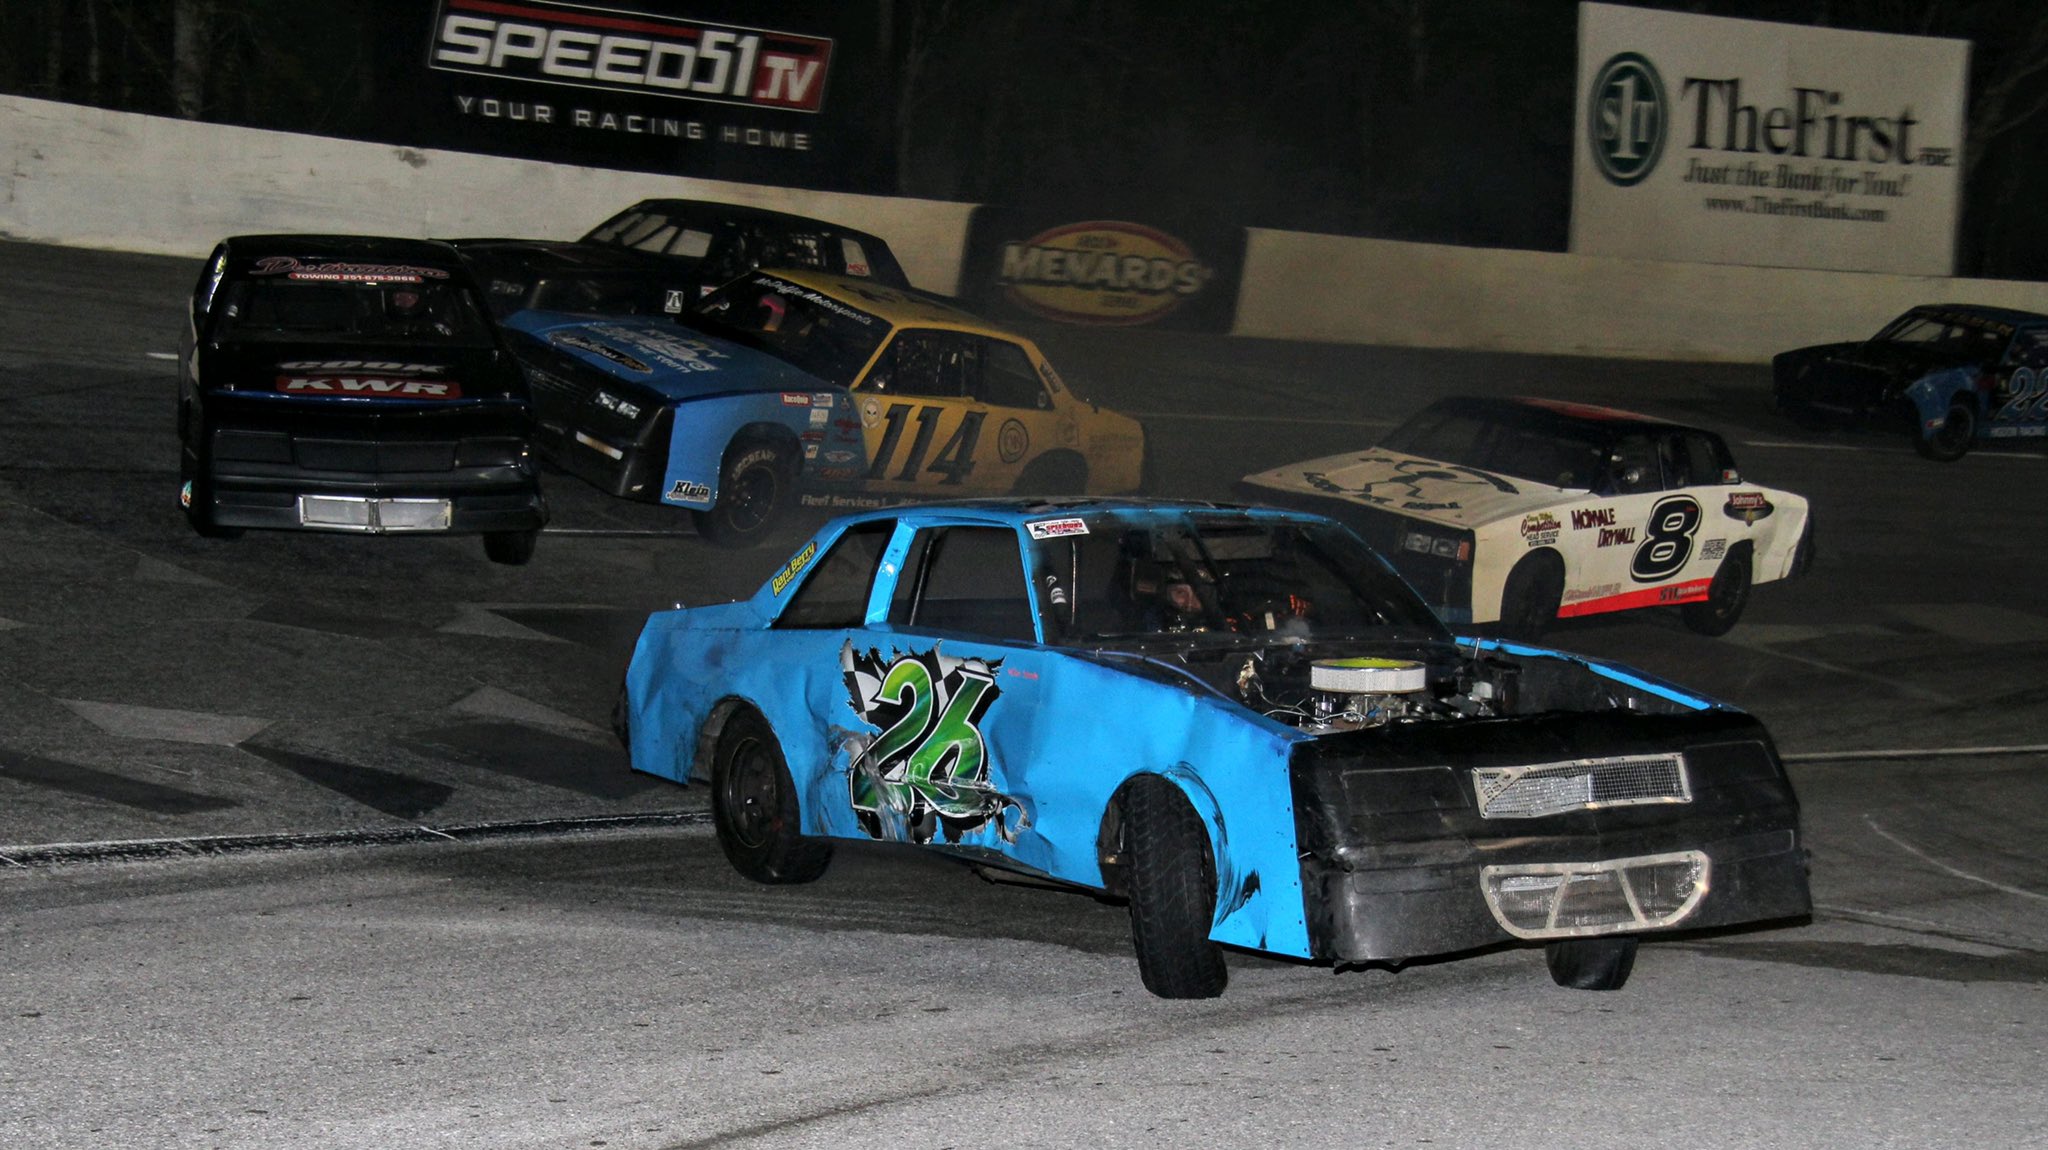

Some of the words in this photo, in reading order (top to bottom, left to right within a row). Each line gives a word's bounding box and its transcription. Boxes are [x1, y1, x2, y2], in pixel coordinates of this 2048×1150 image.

[458, 95, 552, 122] YOUR
[575, 109, 703, 140] RACING
[723, 125, 811, 151] HOME
[1683, 157, 1731, 185] Just
[1735, 161, 1771, 187] the
[1776, 163, 1822, 192] Bank
[1824, 168, 1858, 198] for
[286, 378, 449, 396] KWR
[859, 403, 989, 485] 114
[673, 481, 710, 496] Klein
[832, 495, 881, 508] Services
[1732, 494, 1764, 507] Johnny's
[1540, 530, 1560, 540] SERVICE
[1597, 527, 1637, 549] DRYWALL
[1630, 494, 1703, 583] 8
